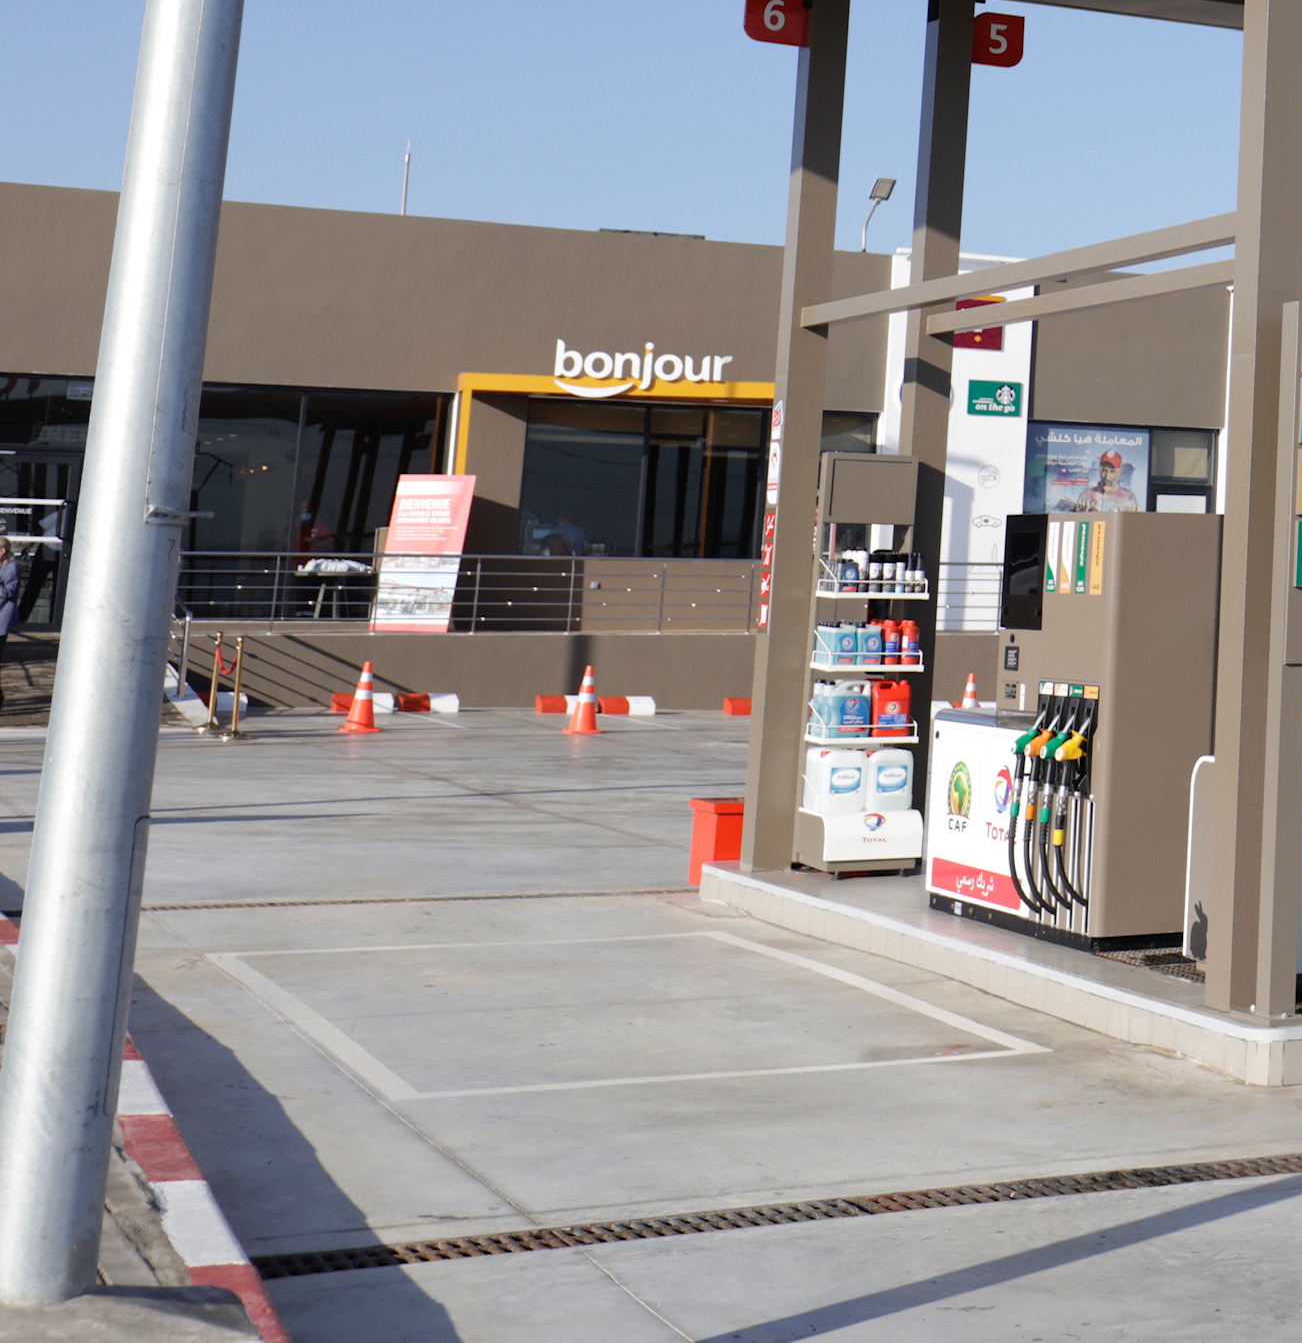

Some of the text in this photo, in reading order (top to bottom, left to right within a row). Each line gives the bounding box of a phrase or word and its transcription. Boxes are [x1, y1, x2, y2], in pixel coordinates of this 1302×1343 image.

[763, 0, 786, 31] 6
[988, 23, 1008, 54] 5
[554, 338, 733, 390] bonjour
[1094, 434, 1142, 446] المعاملة
[399, 498, 451, 510] BIENVENUE
[948, 818, 967, 833] CAF
[956, 872, 994, 896] شريك رسمي
